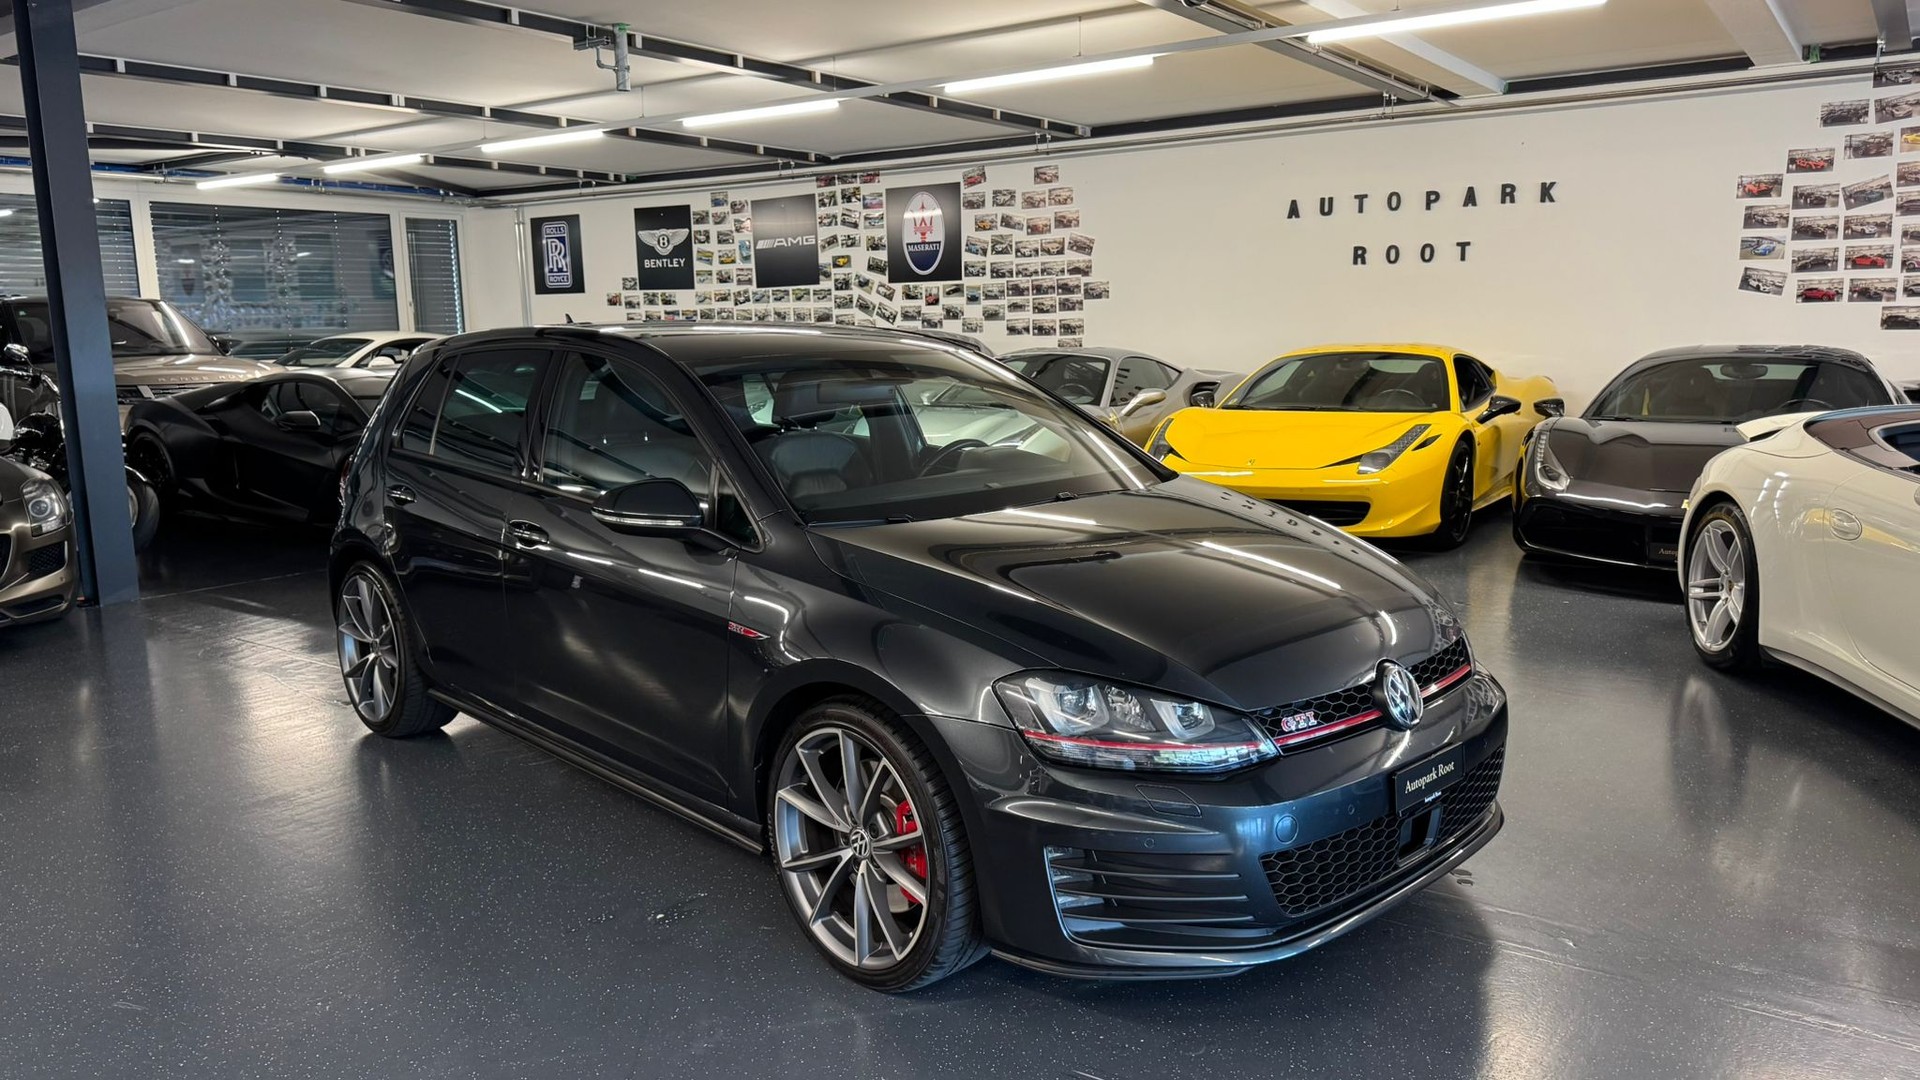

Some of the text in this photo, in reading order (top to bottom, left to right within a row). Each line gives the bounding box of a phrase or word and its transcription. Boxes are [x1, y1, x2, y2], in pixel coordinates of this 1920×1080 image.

[1287, 182, 1557, 219] AUTOPARK
[907, 243, 940, 252] MASERATI
[1352, 241, 1471, 266] ROOT
[644, 258, 685, 268] BENTLEY
[1281, 711, 1317, 732] GTI
[1405, 761, 1455, 794] Autopark Root
